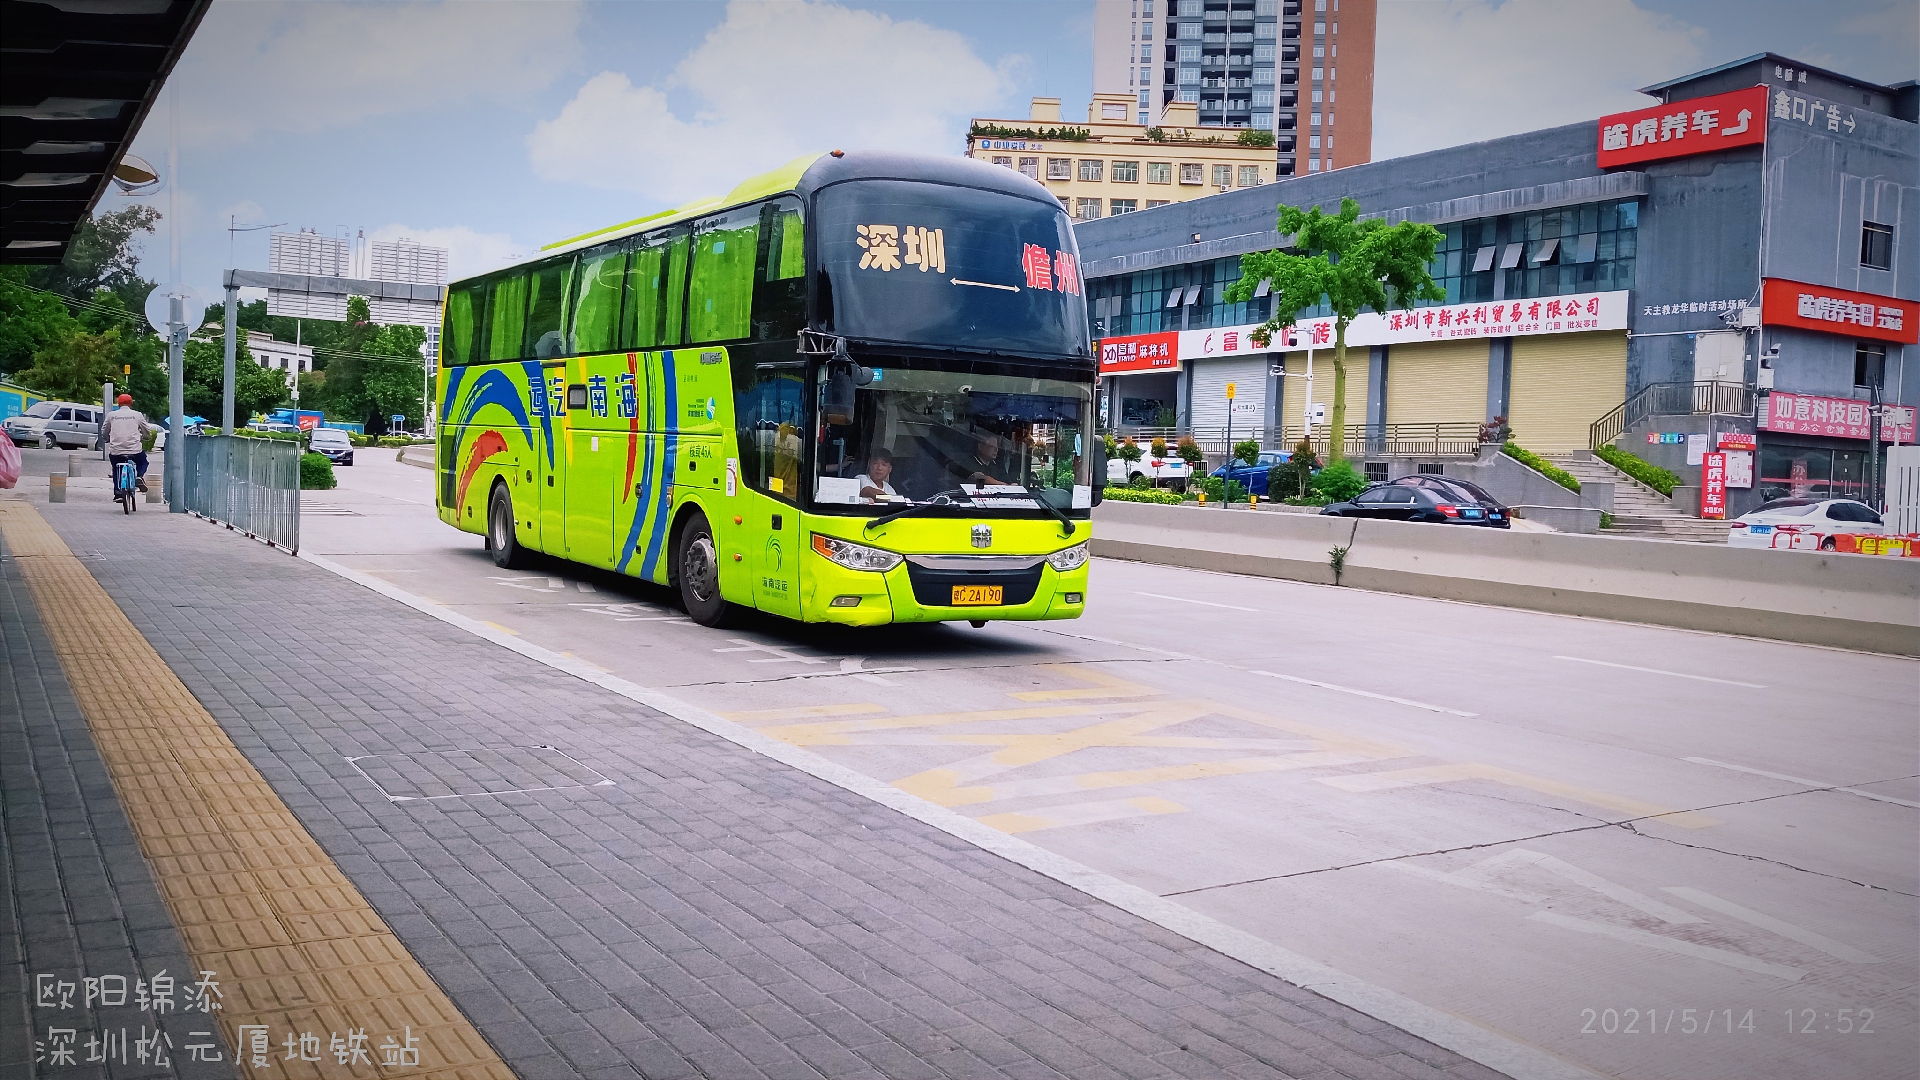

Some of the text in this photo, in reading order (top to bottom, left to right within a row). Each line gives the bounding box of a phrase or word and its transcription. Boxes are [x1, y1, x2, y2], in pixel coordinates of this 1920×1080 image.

[1602, 109, 1720, 151] 途虎养车
[856, 224, 1080, 297] 深圳 儋州
[1389, 296, 1601, 332] 深圳市新兴利贸易有限公司
[1643, 298, 1748, 316] 天主教龙华临时活动场所
[1138, 342, 1169, 358] 麻将机
[1706, 454, 1723, 506] 途虎养车
